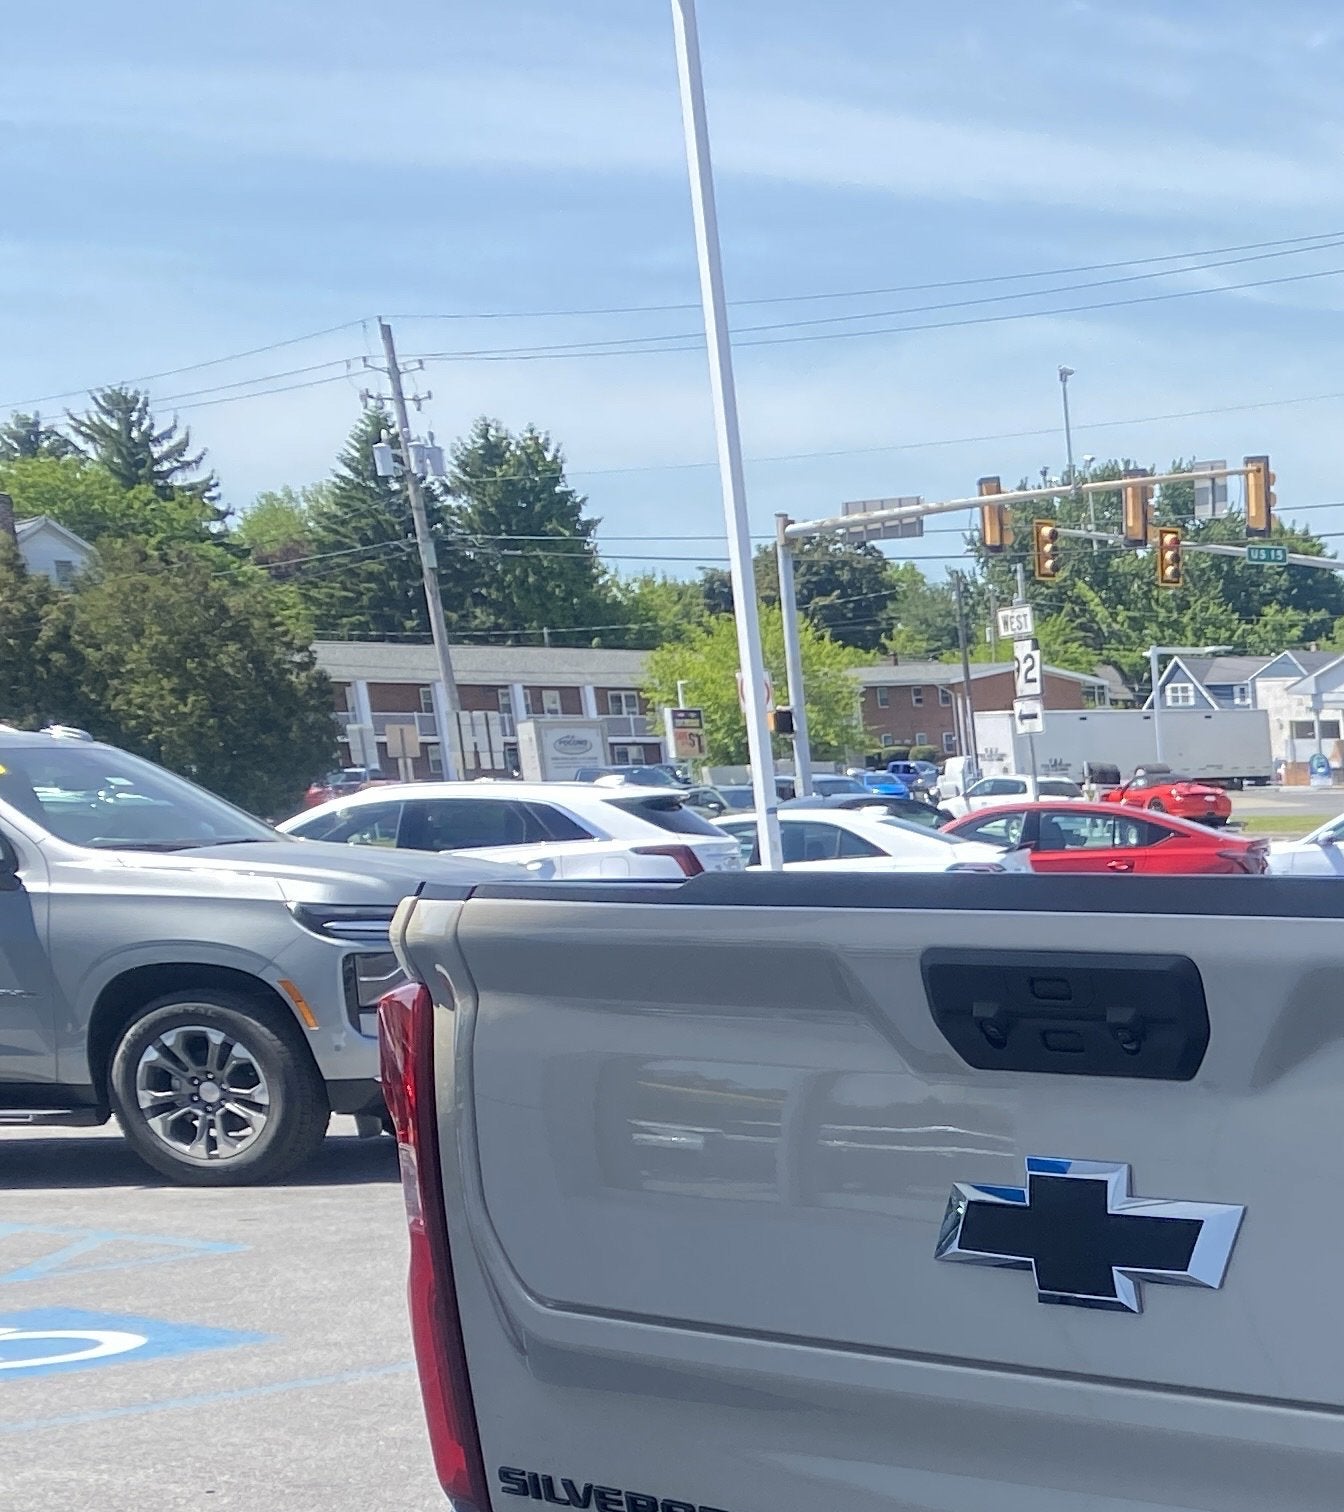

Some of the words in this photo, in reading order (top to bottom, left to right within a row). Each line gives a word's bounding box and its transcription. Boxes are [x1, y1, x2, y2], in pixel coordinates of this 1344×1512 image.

[1250, 549, 1266, 560] US
[1270, 549, 1283, 561] 15
[1001, 613, 1028, 633] WEST
